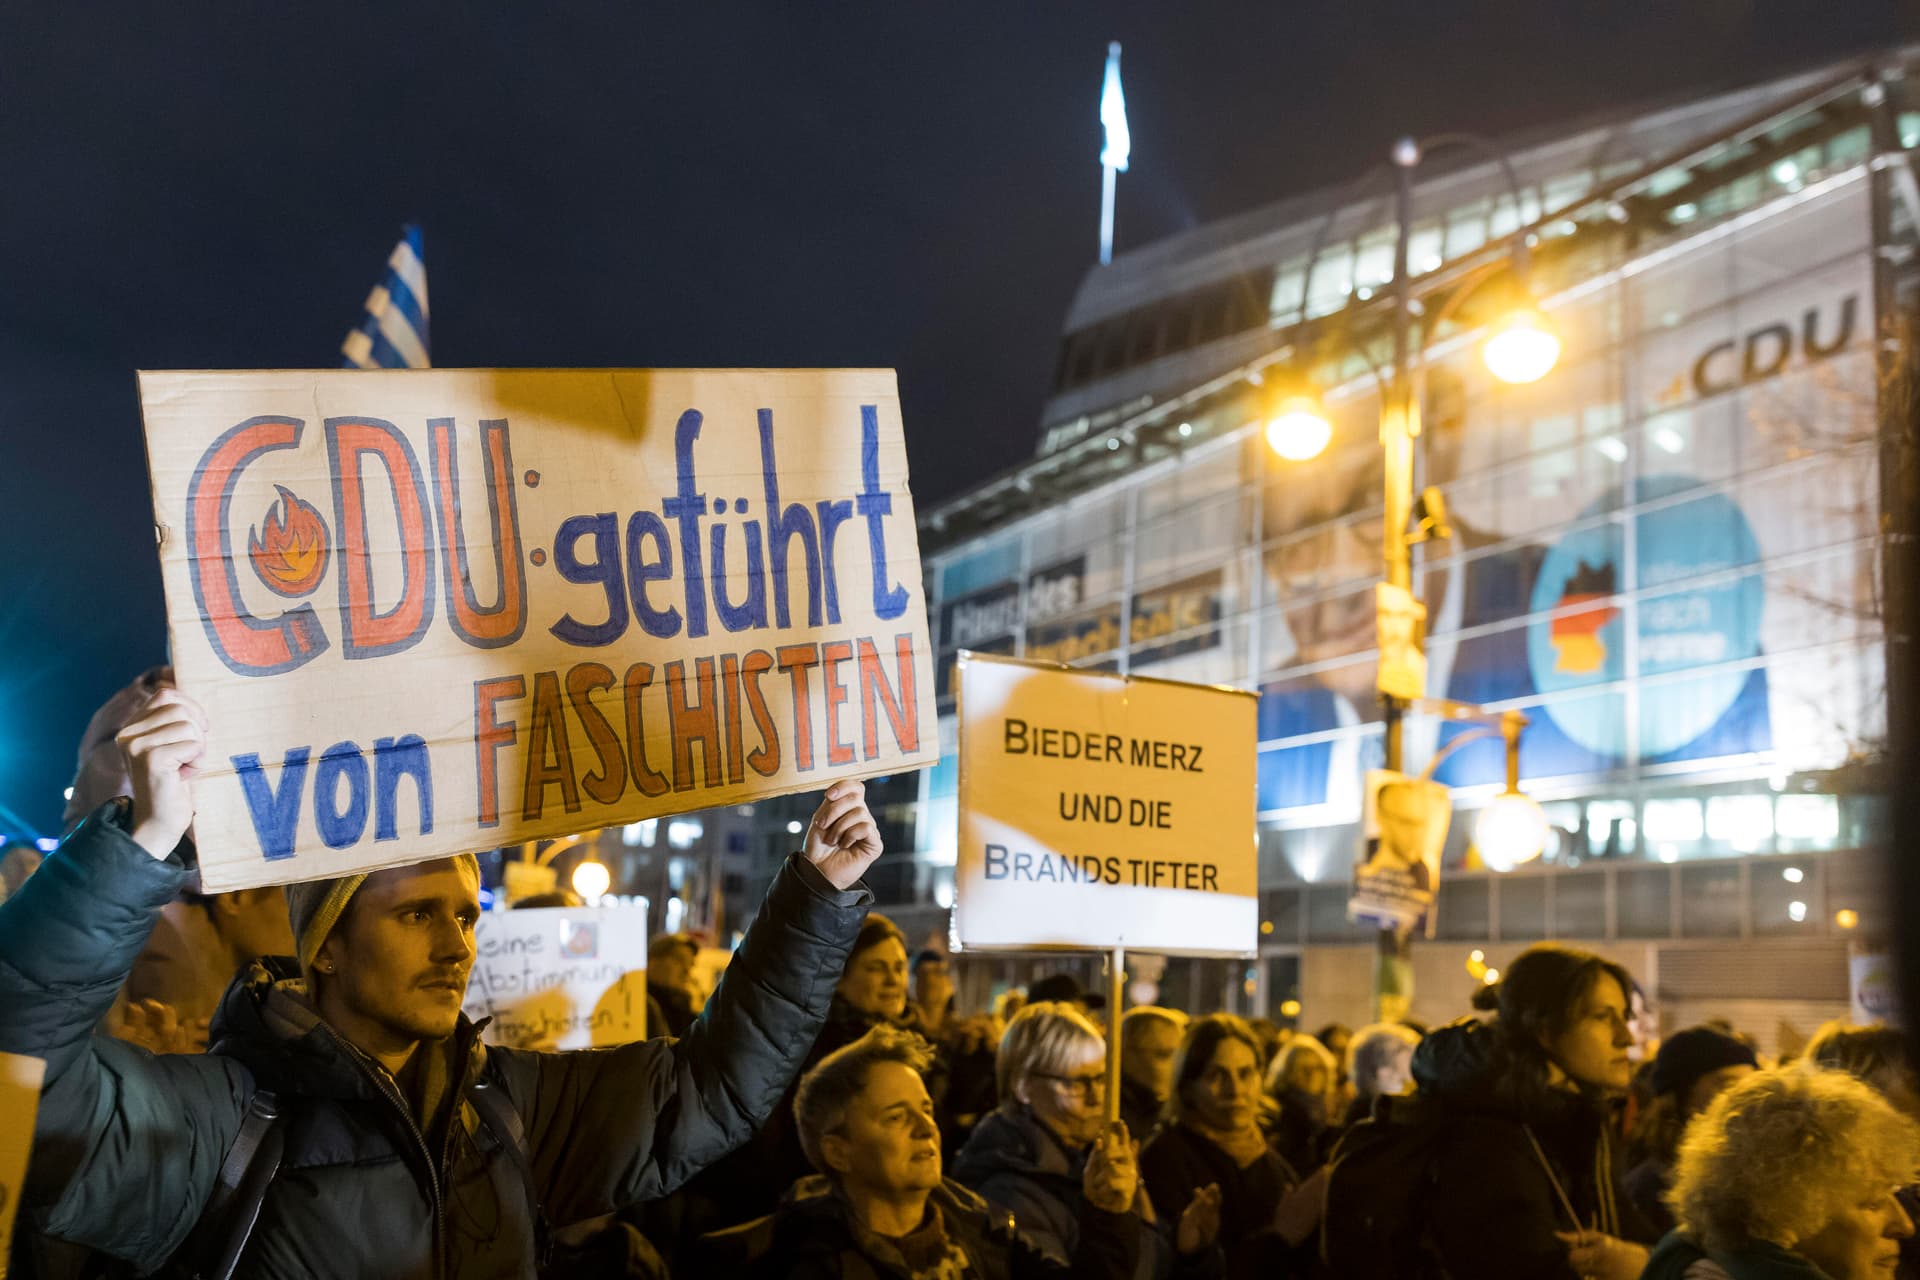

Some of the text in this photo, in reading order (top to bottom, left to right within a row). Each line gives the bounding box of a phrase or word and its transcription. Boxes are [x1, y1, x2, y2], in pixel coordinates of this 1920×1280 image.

[1692, 296, 1858, 398] CDU
[230, 632, 921, 861] von FASCHISTEN
[1060, 792, 1172, 829] UND DIE
